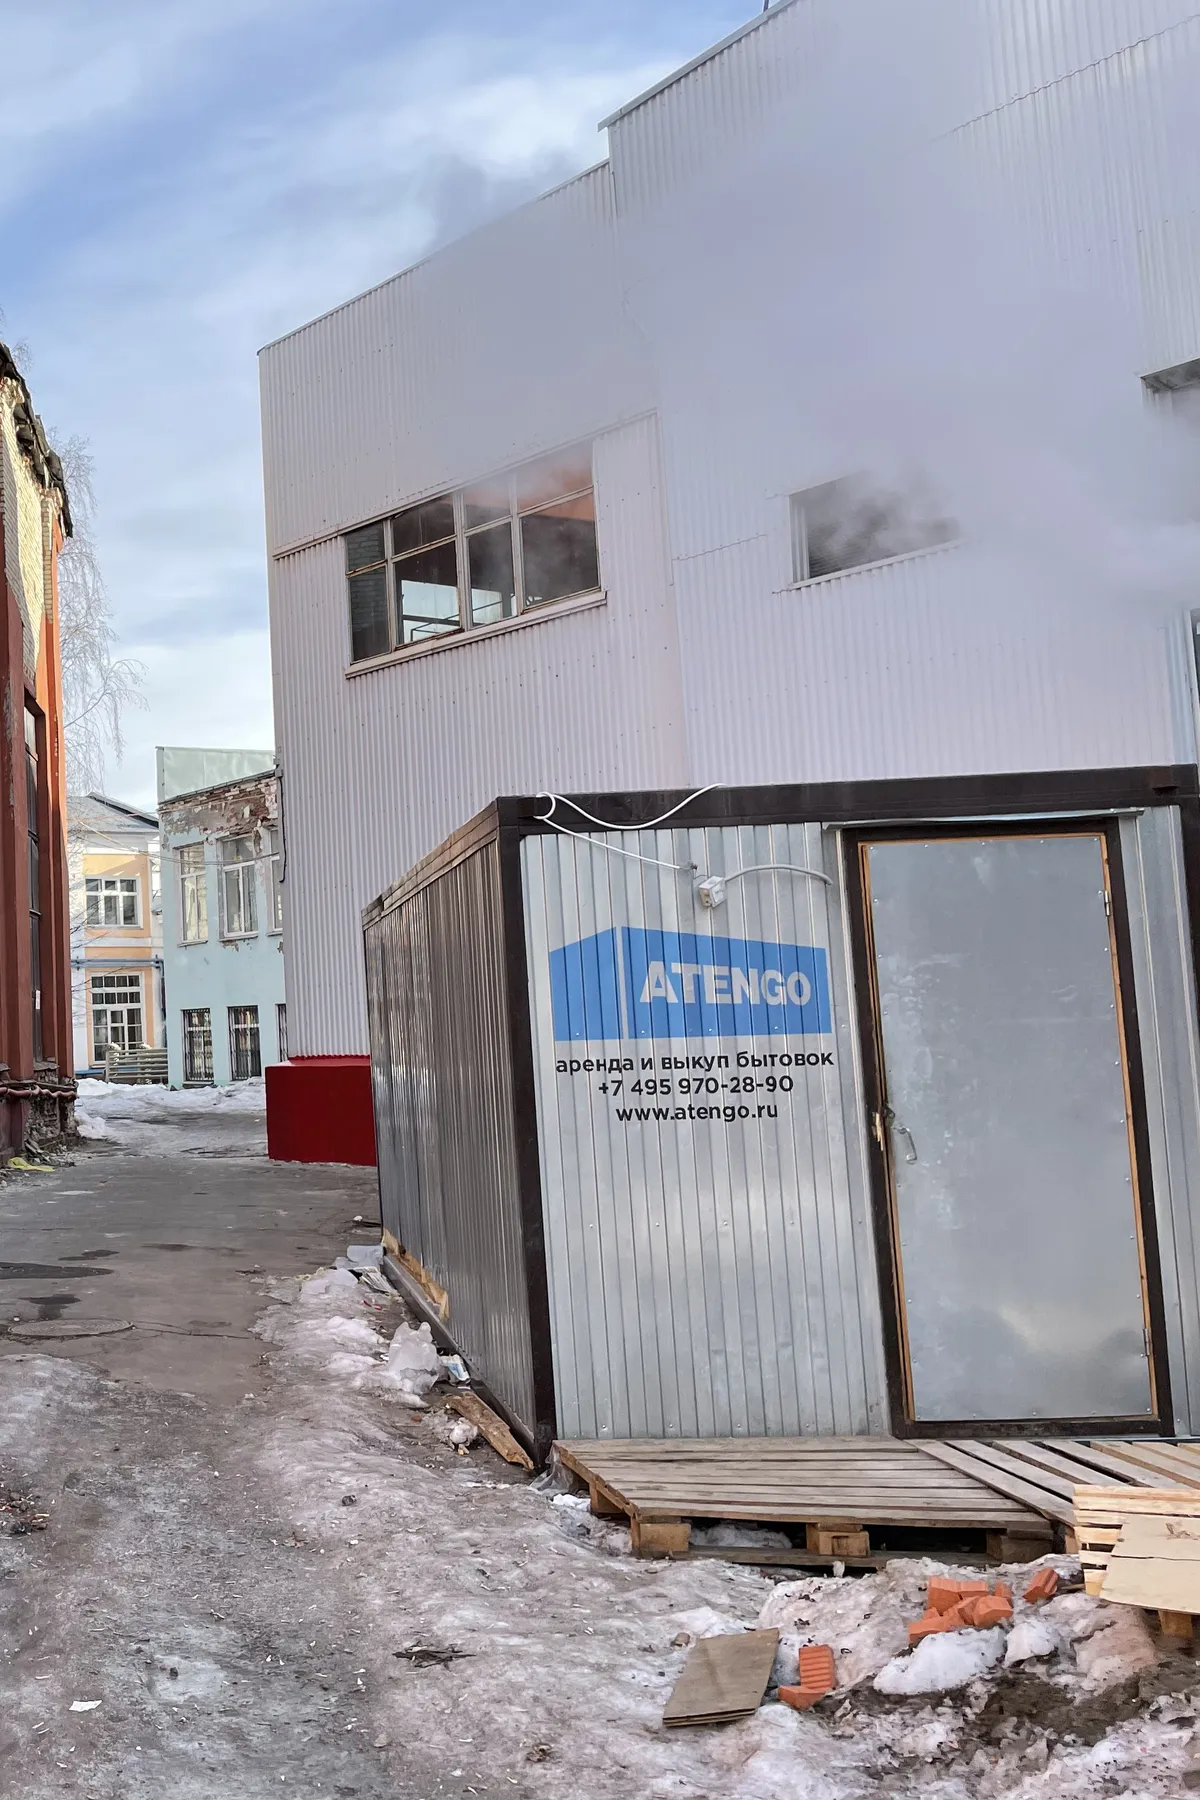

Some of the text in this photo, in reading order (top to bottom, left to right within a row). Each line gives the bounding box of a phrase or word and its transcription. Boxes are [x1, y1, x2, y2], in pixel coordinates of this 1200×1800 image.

[639, 961, 811, 1006] ATENGO
[556, 1051, 834, 1076] аренда и выкуп бытовок
[598, 1075, 794, 1097] +7 495 970-28-90
[616, 1103, 778, 1122] www.atengo.ru
